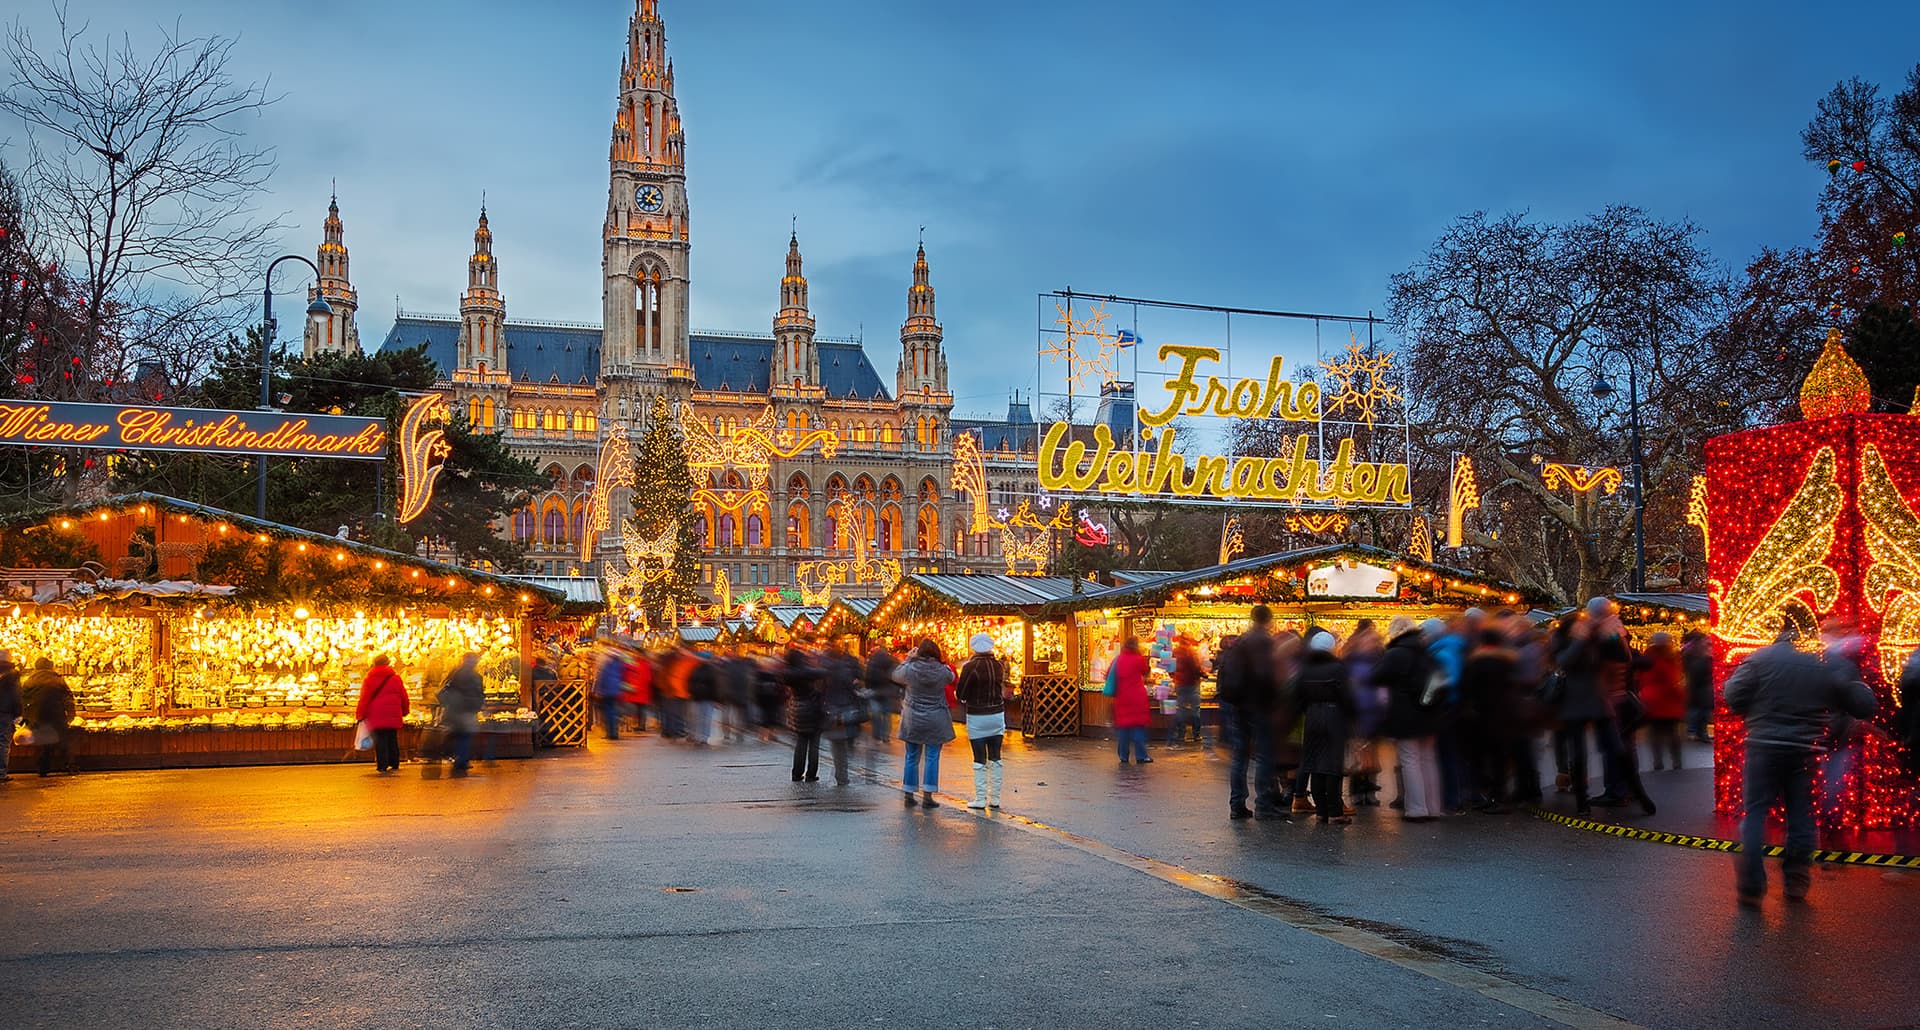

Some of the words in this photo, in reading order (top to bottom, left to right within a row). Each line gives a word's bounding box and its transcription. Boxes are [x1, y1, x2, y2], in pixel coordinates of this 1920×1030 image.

[1138, 344, 1320, 427] Frohe
[0, 405, 109, 441] Wiener
[117, 409, 385, 453] Christkindlmarkt
[1038, 421, 1412, 503] Weihnachten
